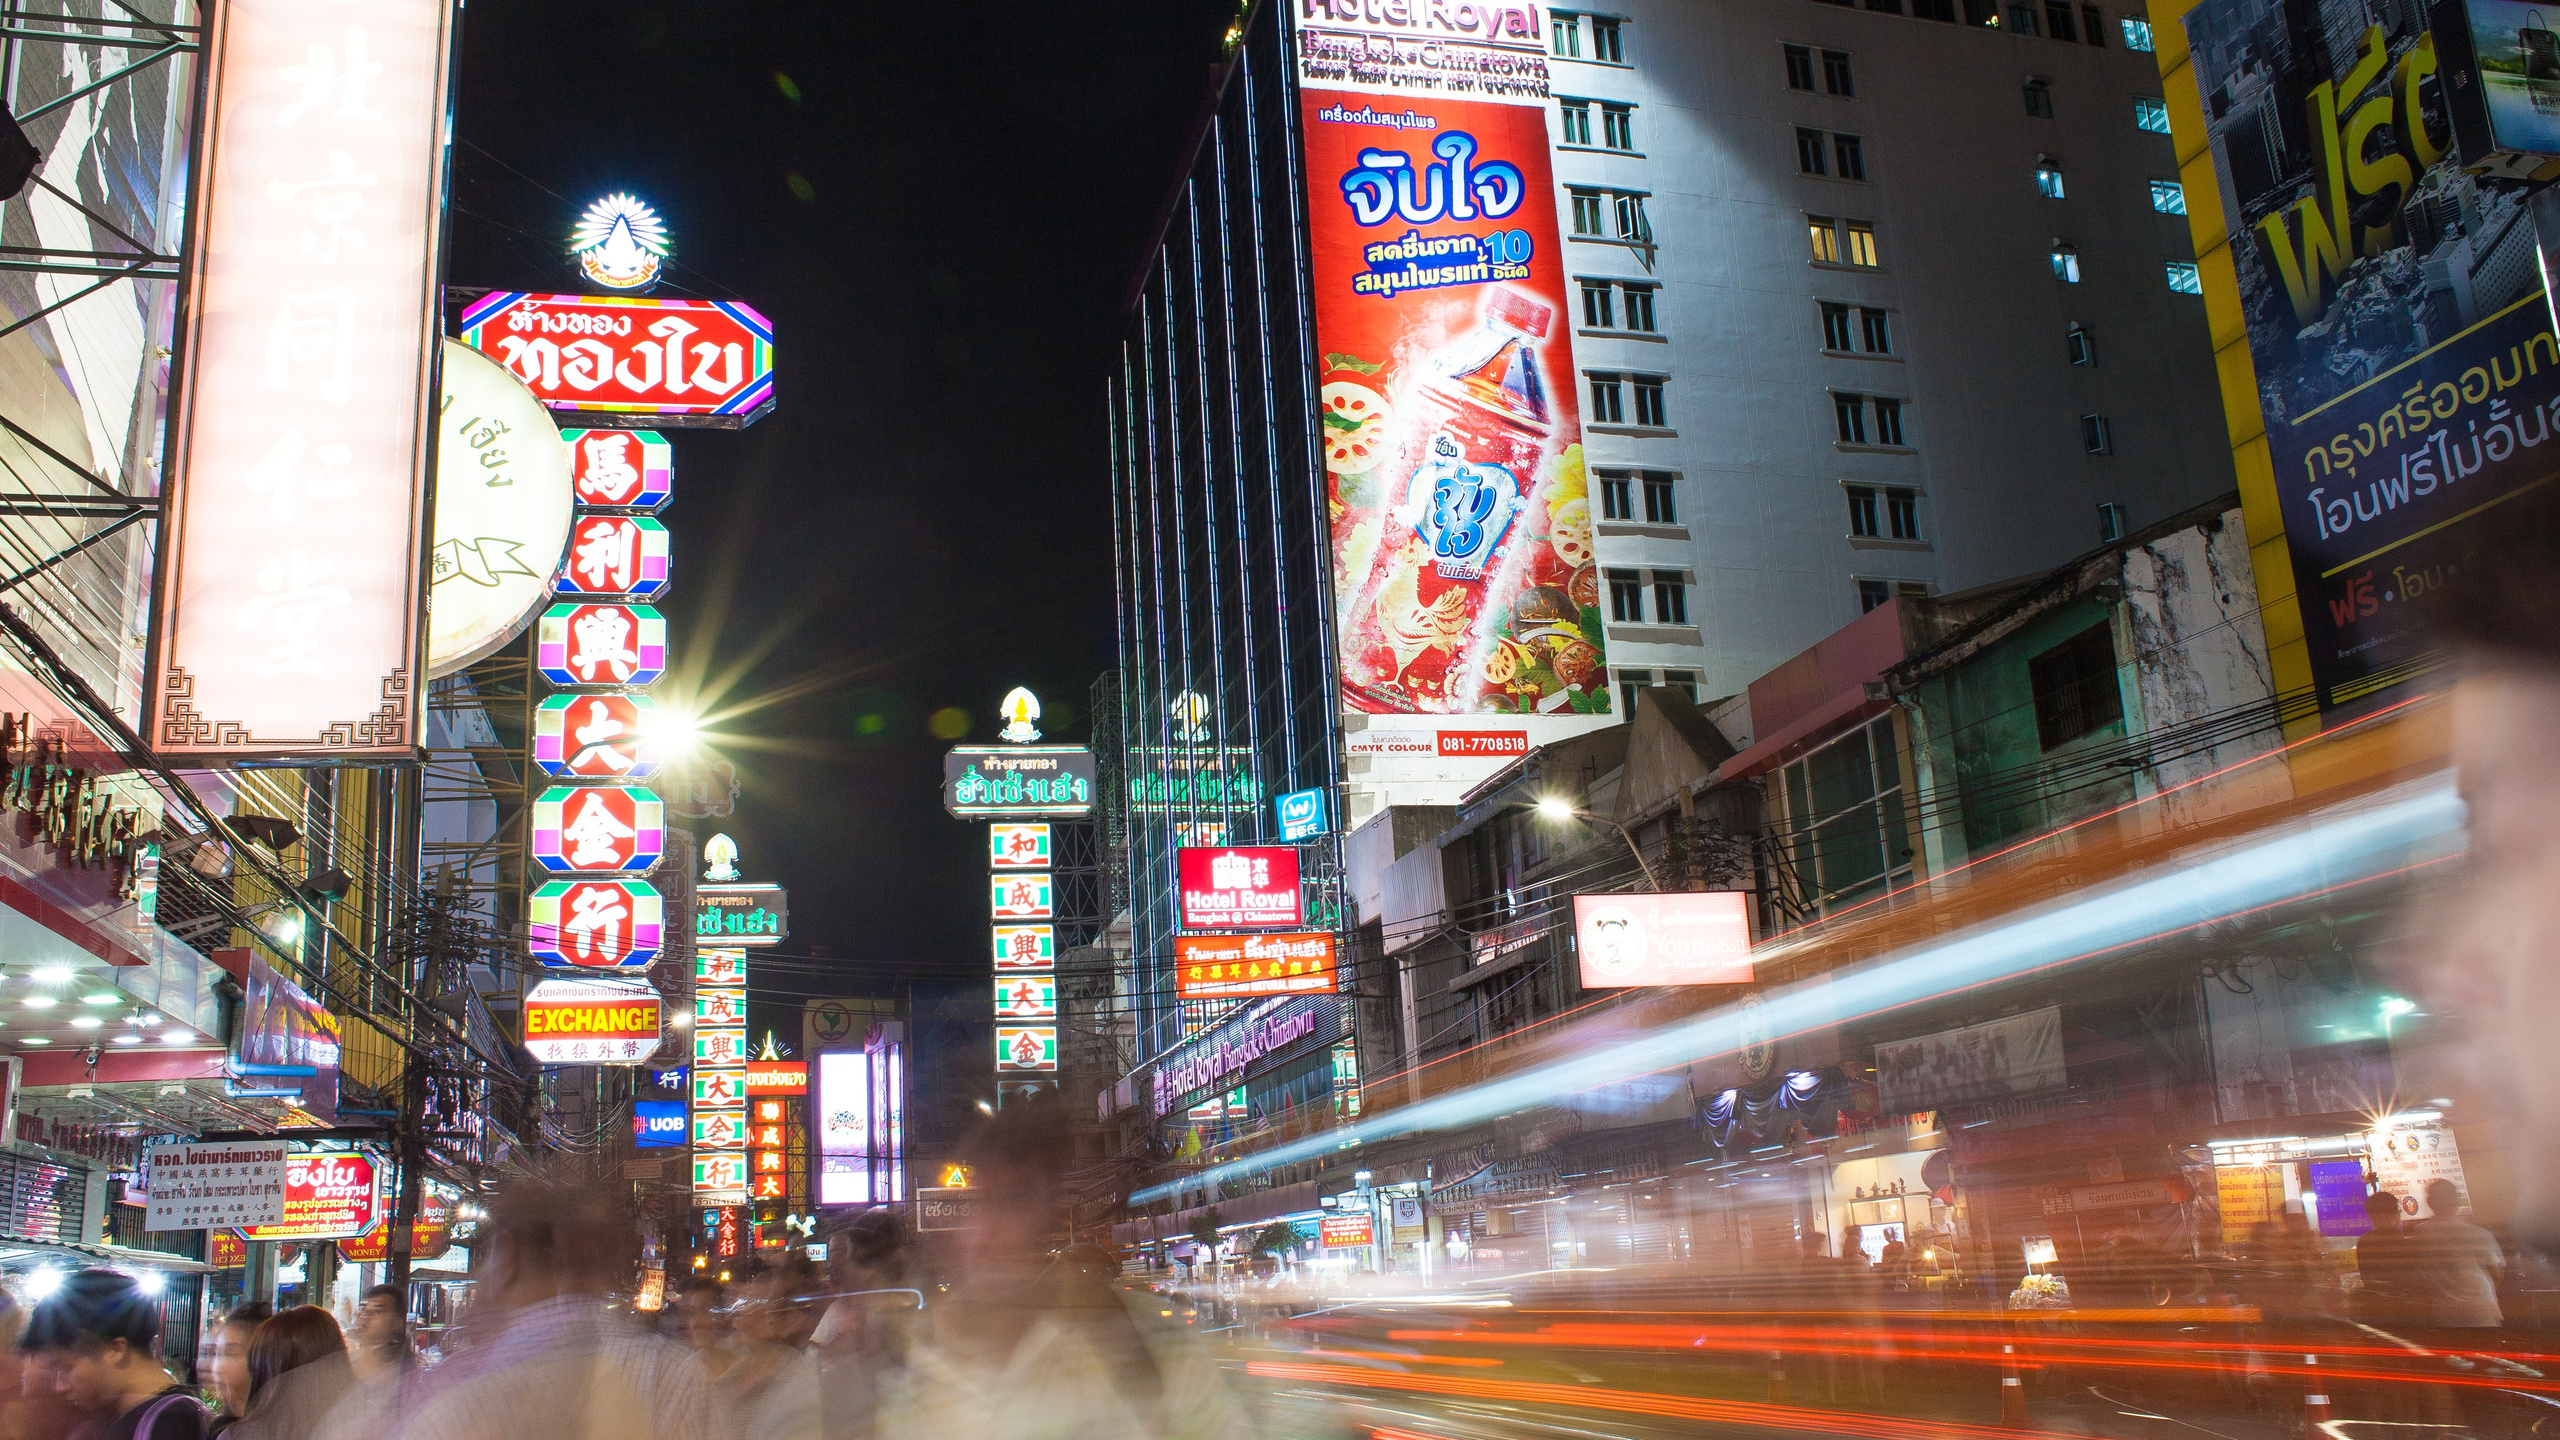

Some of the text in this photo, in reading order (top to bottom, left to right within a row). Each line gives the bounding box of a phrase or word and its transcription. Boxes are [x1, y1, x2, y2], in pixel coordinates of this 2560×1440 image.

[1306, 29, 1402, 63] Bangkok
[1420, 40, 1547, 72] Chinatown
[1342, 132, 1523, 226] จับใจ
[1367, 230, 1532, 264] สดชื่นจาก 10
[1355, 246, 1528, 296] สมุนไพรแท้ ชนิด
[508, 302, 631, 335] ห้างทอง
[235, 24, 383, 677] 北京同仁堂
[497, 316, 743, 395] ทองใบ
[2329, 570, 2379, 628] ฟรี
[1351, 743, 1433, 752] CMYK COLOUR
[1442, 737, 1526, 752] 081-7708518
[1185, 889, 1296, 909] Hotel Royal
[697, 905, 778, 934] เซ่งเฮง
[1188, 912, 1296, 924] Bangkok @ Chinatown
[1692, 938, 1747, 954] Fishball
[1008, 830, 1045, 1095] 和成興大金
[527, 1007, 656, 1033] EXCHANGE
[1172, 1062, 1196, 1097] Hotel
[1196, 1044, 1225, 1087] Royal
[1264, 1009, 1315, 1052] Chinatown
[650, 1117, 685, 1131] UOB
[154, 1153, 184, 1167] หจก.
[287, 1155, 355, 1186] องใบ
[349, 1247, 382, 1256] MONEY
